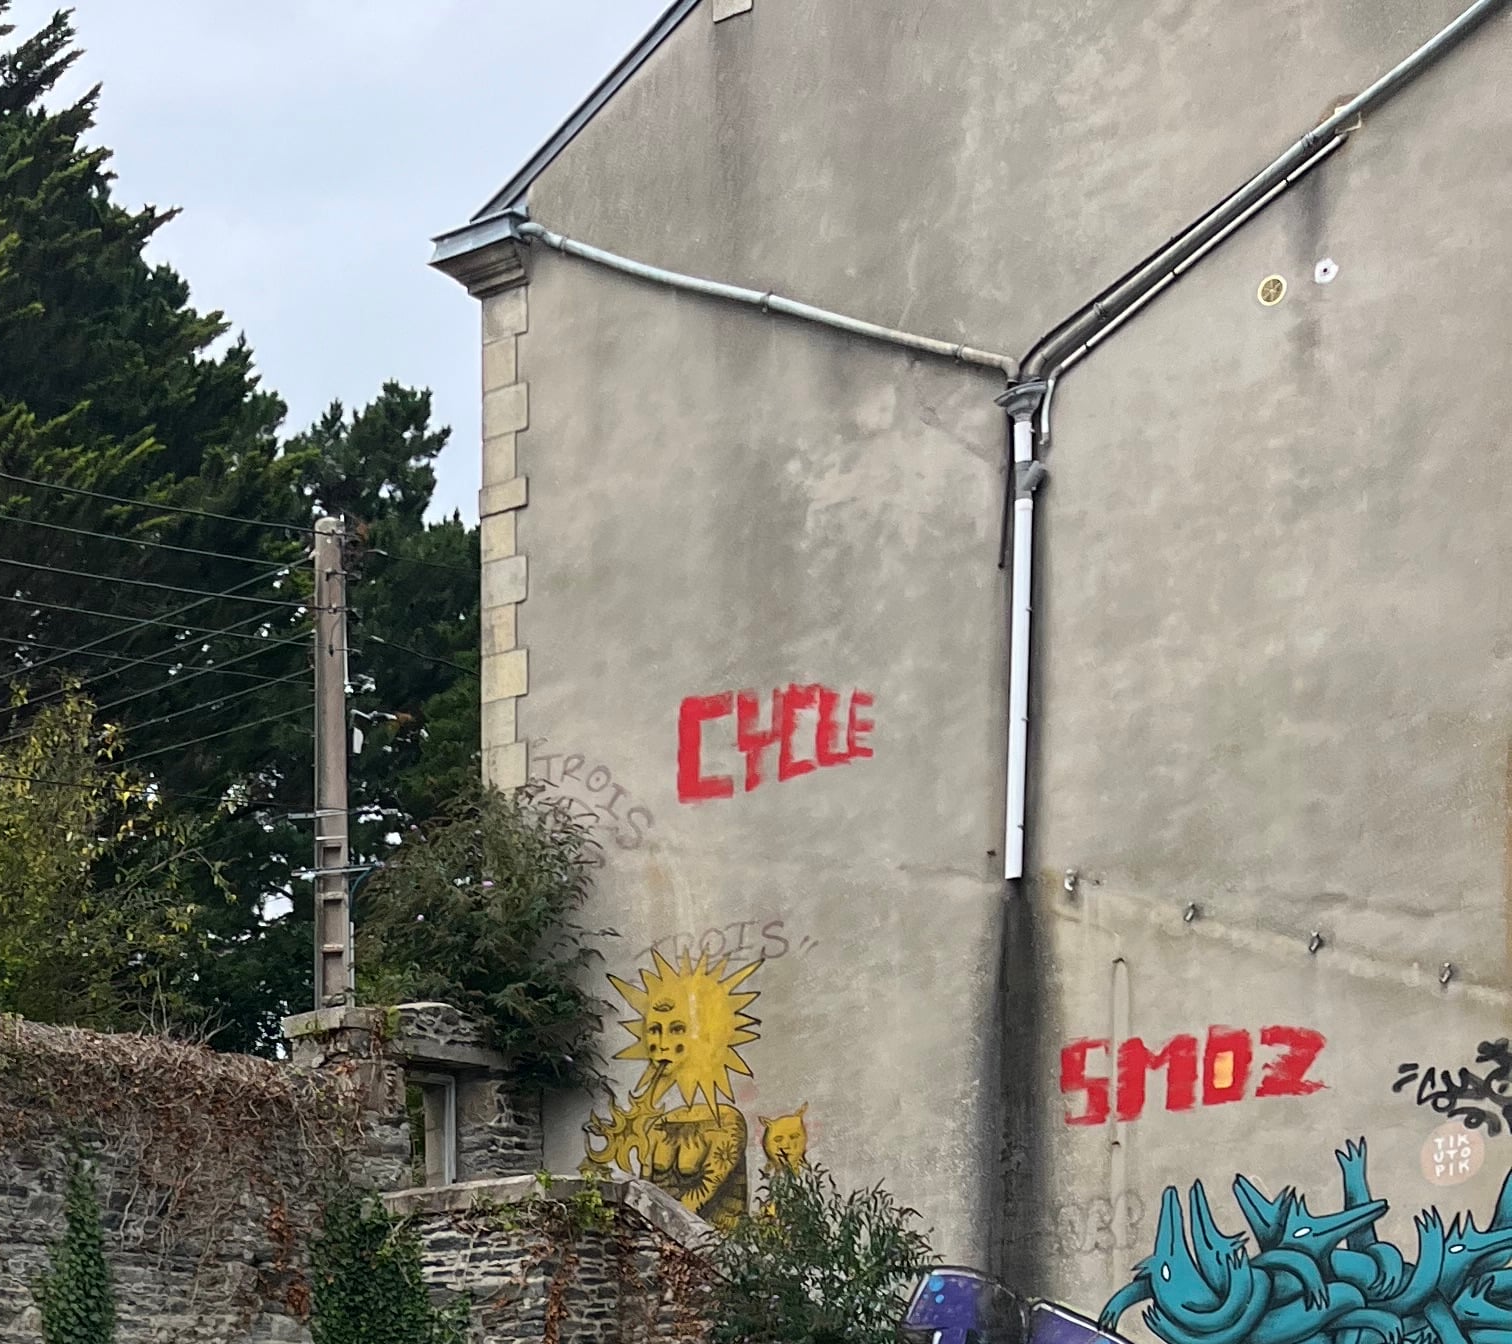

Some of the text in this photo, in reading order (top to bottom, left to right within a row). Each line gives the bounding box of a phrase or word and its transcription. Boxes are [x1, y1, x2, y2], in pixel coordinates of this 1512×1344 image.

[1434, 1135, 1469, 1148] TIK
[1433, 1147, 1471, 1162] UTO
[1435, 1161, 1470, 1177] PIK
